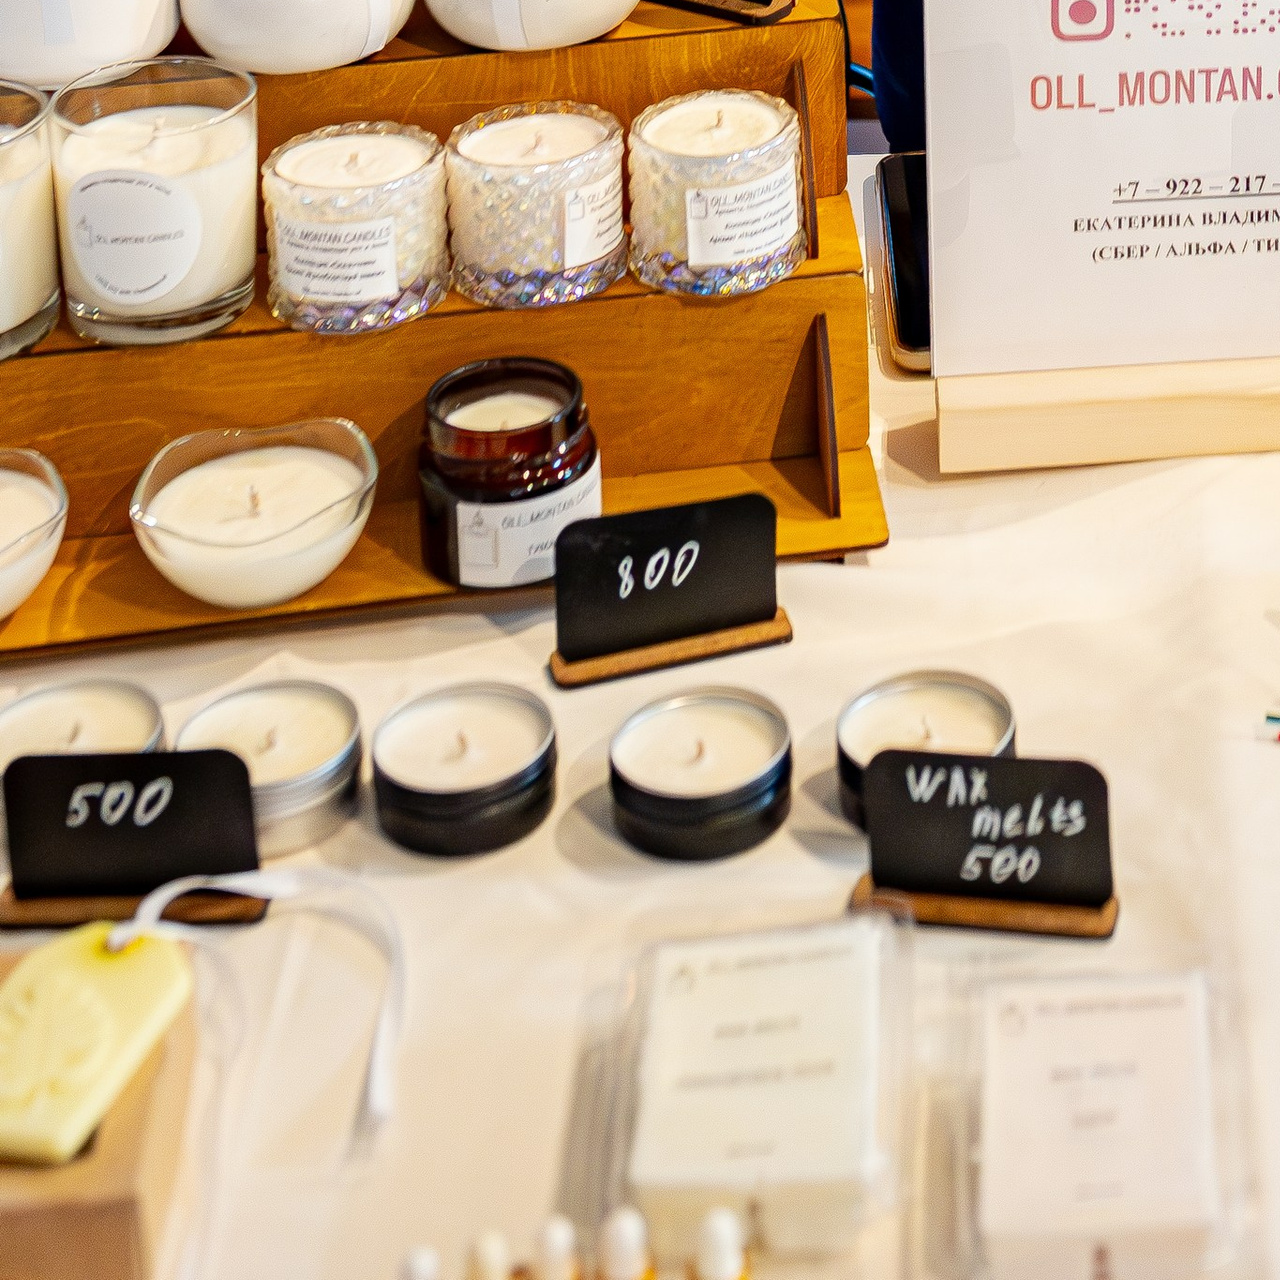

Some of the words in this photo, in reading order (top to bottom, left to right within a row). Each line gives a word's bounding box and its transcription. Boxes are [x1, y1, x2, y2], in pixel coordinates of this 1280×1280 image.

[1113, 180, 1141, 198] +7
[1165, 178, 1203, 196] 922
[1229, 174, 1267, 195] 217
[1072, 212, 1195, 233] ЕКАТЕРИНА
[1091, 244, 1151, 264] (СБЕР
[1165, 240, 1237, 258] АЛЬФА
[618, 540, 700, 599] 800
[66, 776, 174, 829] 500
[960, 844, 1042, 884] 500
